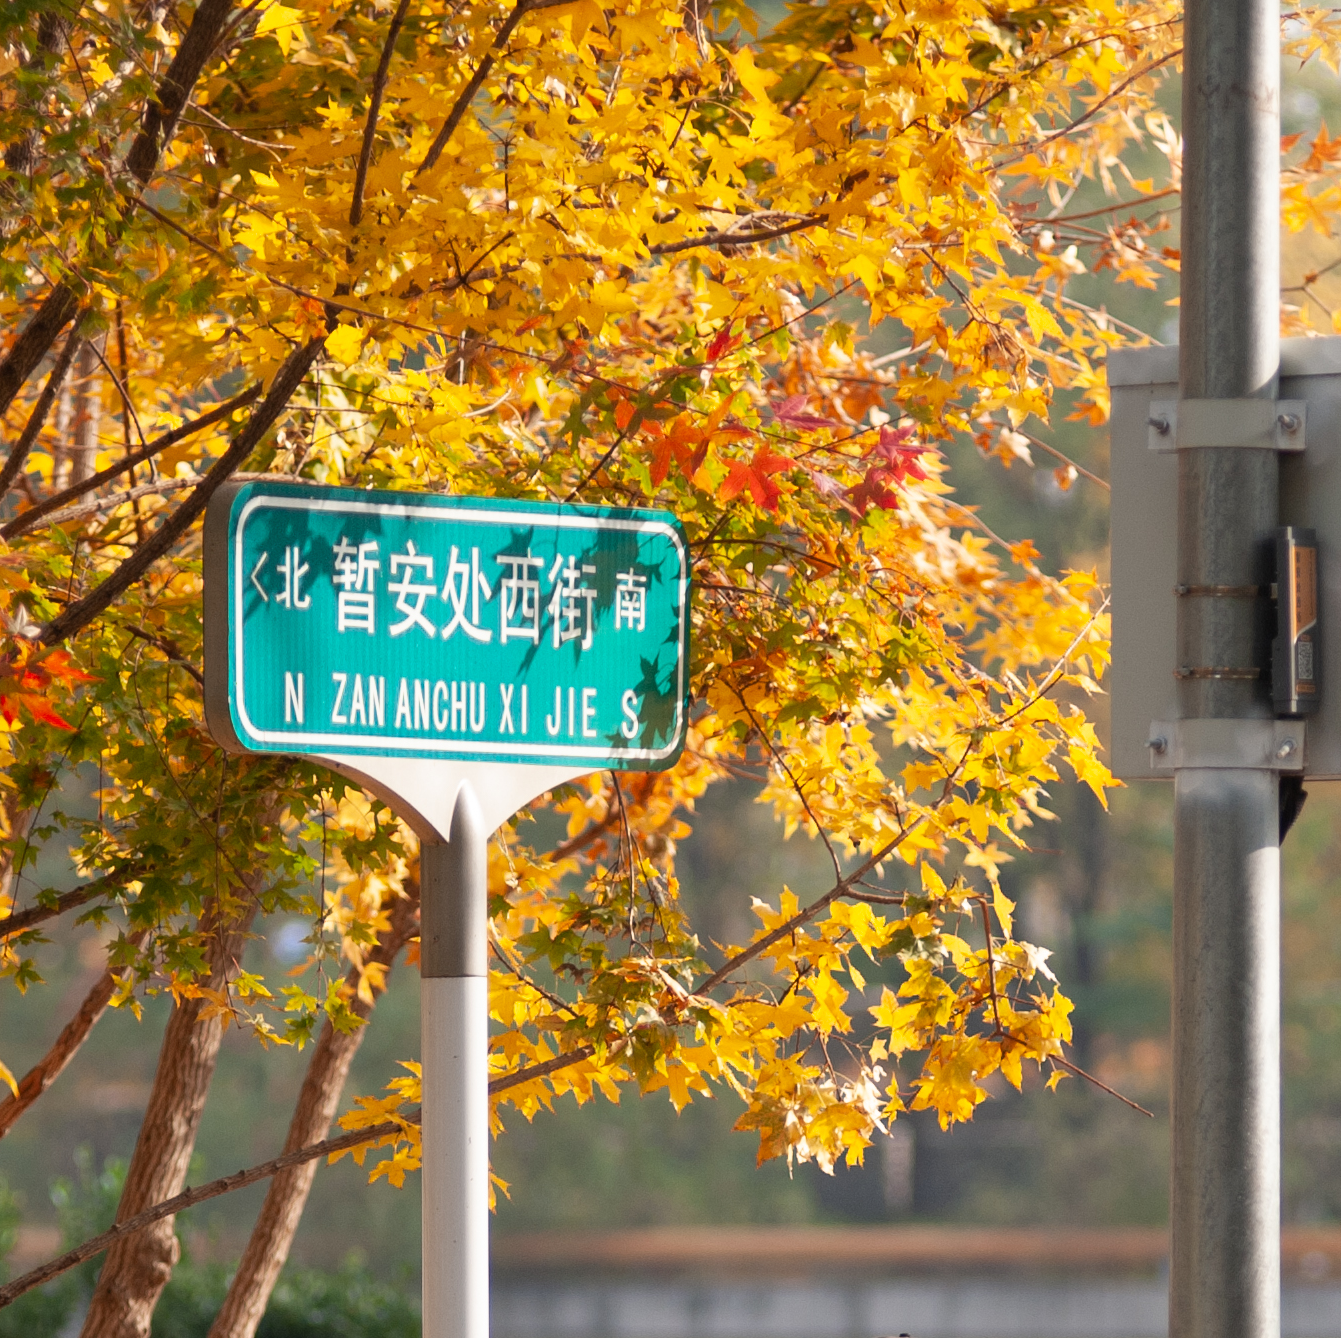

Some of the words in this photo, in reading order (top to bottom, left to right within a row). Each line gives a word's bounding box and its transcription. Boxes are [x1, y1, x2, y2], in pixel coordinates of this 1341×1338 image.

[276, 546, 311, 609] 北
[332, 536, 598, 650] 暂安处西街
[616, 567, 647, 631] 南
[285, 671, 303, 723] N
[332, 672, 385, 726] ZAN
[395, 677, 485, 732] ANCHU
[499, 683, 527, 734] XI
[546, 685, 597, 737] JIE
[621, 688, 639, 739] S
